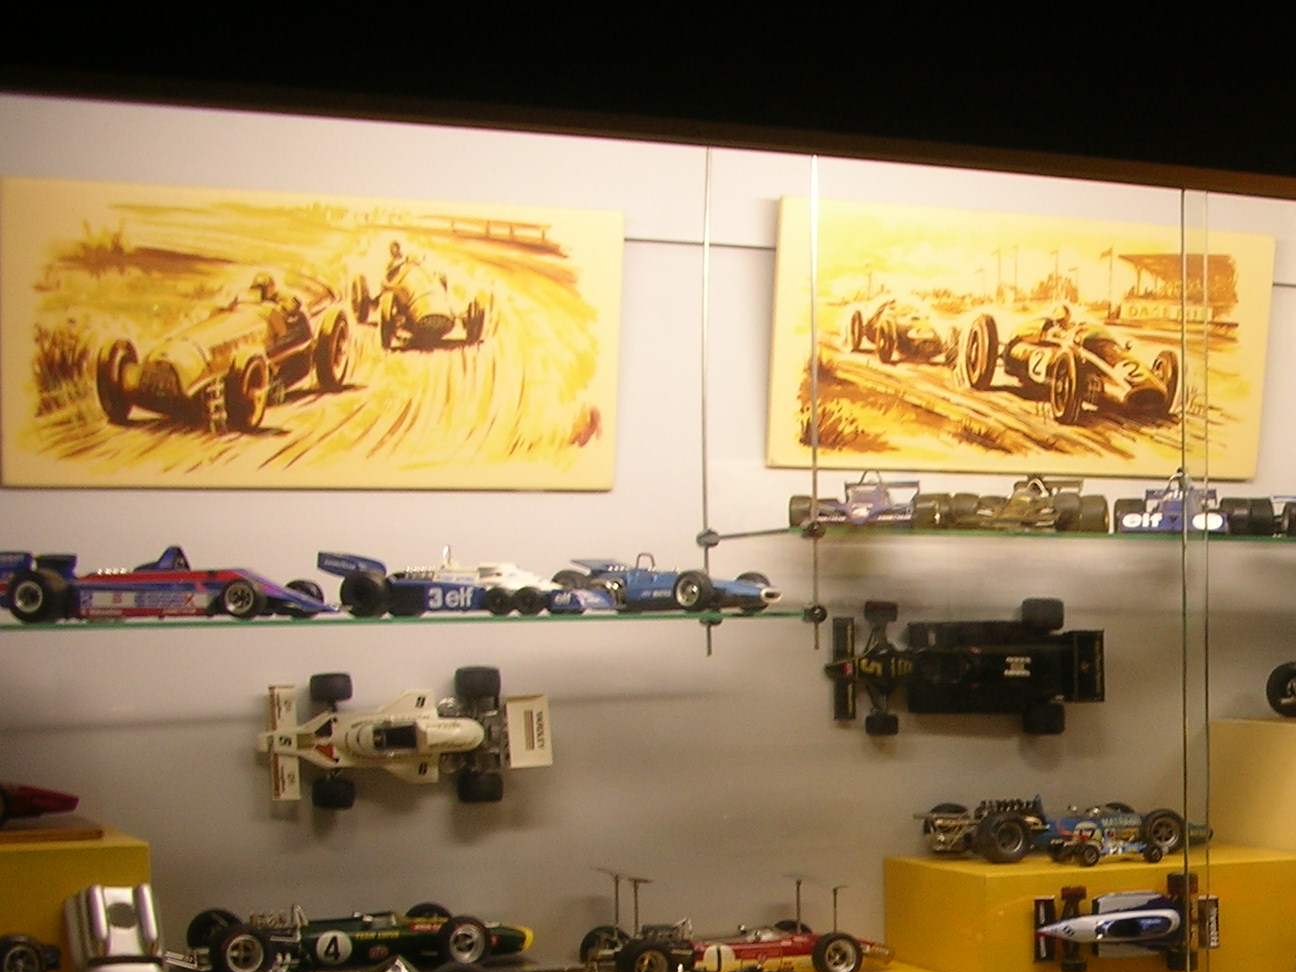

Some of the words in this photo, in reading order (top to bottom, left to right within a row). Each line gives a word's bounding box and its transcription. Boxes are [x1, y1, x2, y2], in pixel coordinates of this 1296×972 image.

[1122, 512, 1163, 528] elf
[428, 586, 443, 609] 3
[445, 586, 474, 608] elf
[324, 935, 340, 961] 4
